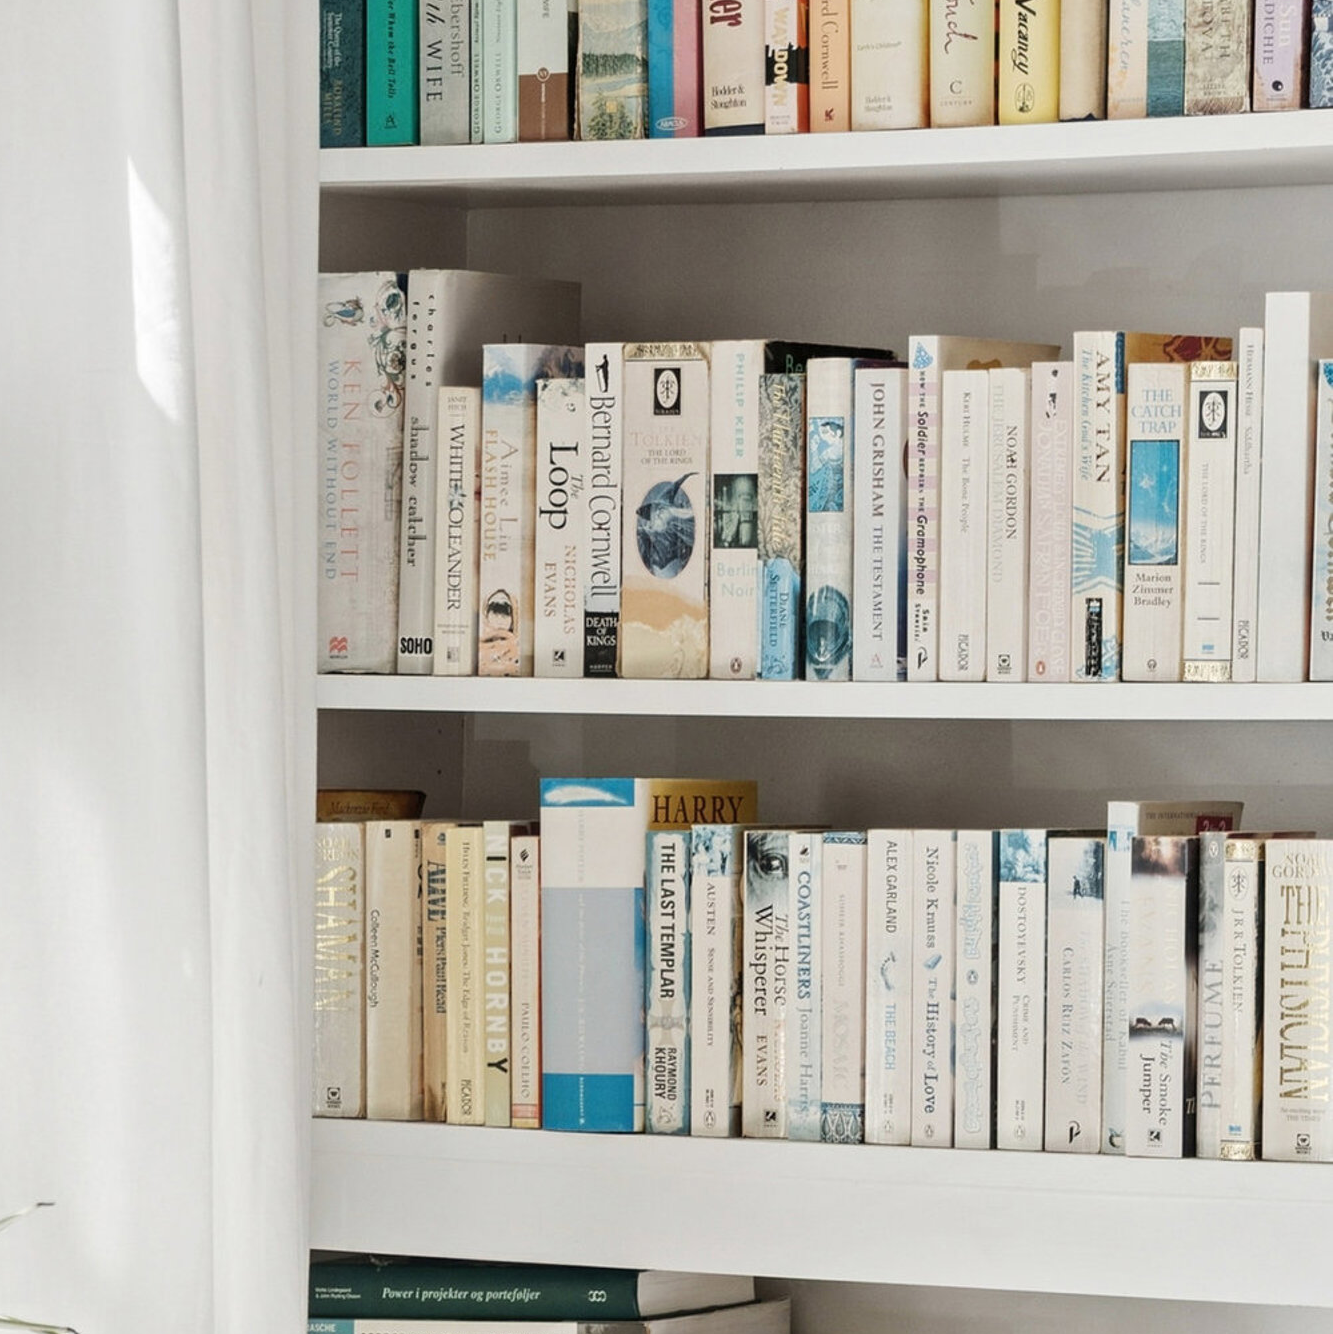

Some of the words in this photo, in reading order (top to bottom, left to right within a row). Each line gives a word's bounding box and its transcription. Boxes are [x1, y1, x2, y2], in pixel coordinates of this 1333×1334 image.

[426, 39, 444, 102] WIFE
[819, 21, 840, 91] Cornwell
[341, 357, 362, 422] KEN
[1095, 350, 1111, 415] AMY
[407, 416, 430, 488] shadow
[448, 423, 467, 489] WHITE
[587, 395, 618, 489] Bernard
[914, 410, 930, 456] Soldier
[1095, 422, 1111, 484] TAN
[340, 443, 362, 584] FOLLETT
[538, 441, 579, 531] Loop
[406, 495, 428, 568] catcher
[446, 505, 466, 611] OLEANDER
[587, 494, 618, 598] Cornwell
[912, 514, 930, 595] Gramophone
[400, 636, 435, 655] SOHO
[652, 794, 744, 824] HARRY
[661, 842, 676, 874] THE
[885, 839, 898, 873] ALEX
[661, 877, 675, 920] LAST
[706, 881, 718, 936] AUSTEN
[885, 874, 898, 934] GARLAND
[314, 865, 357, 1012] SHAMAN
[660, 923, 675, 1000] TEMPLAR
[750, 903, 777, 1016] Whisperer
[797, 870, 812, 1000] COASTLINERS
[485, 946, 509, 1074] HORNBY
[885, 1002, 897, 1027] THE
[654, 1046, 667, 1100] KHOURY
[667, 1046, 678, 1102] RAYMOND
[885, 1029, 896, 1071] BEACH
[1159, 1040, 1173, 1070] The
[1139, 1053, 1157, 1115] Jumper
[1157, 1072, 1172, 1126] Smoke
